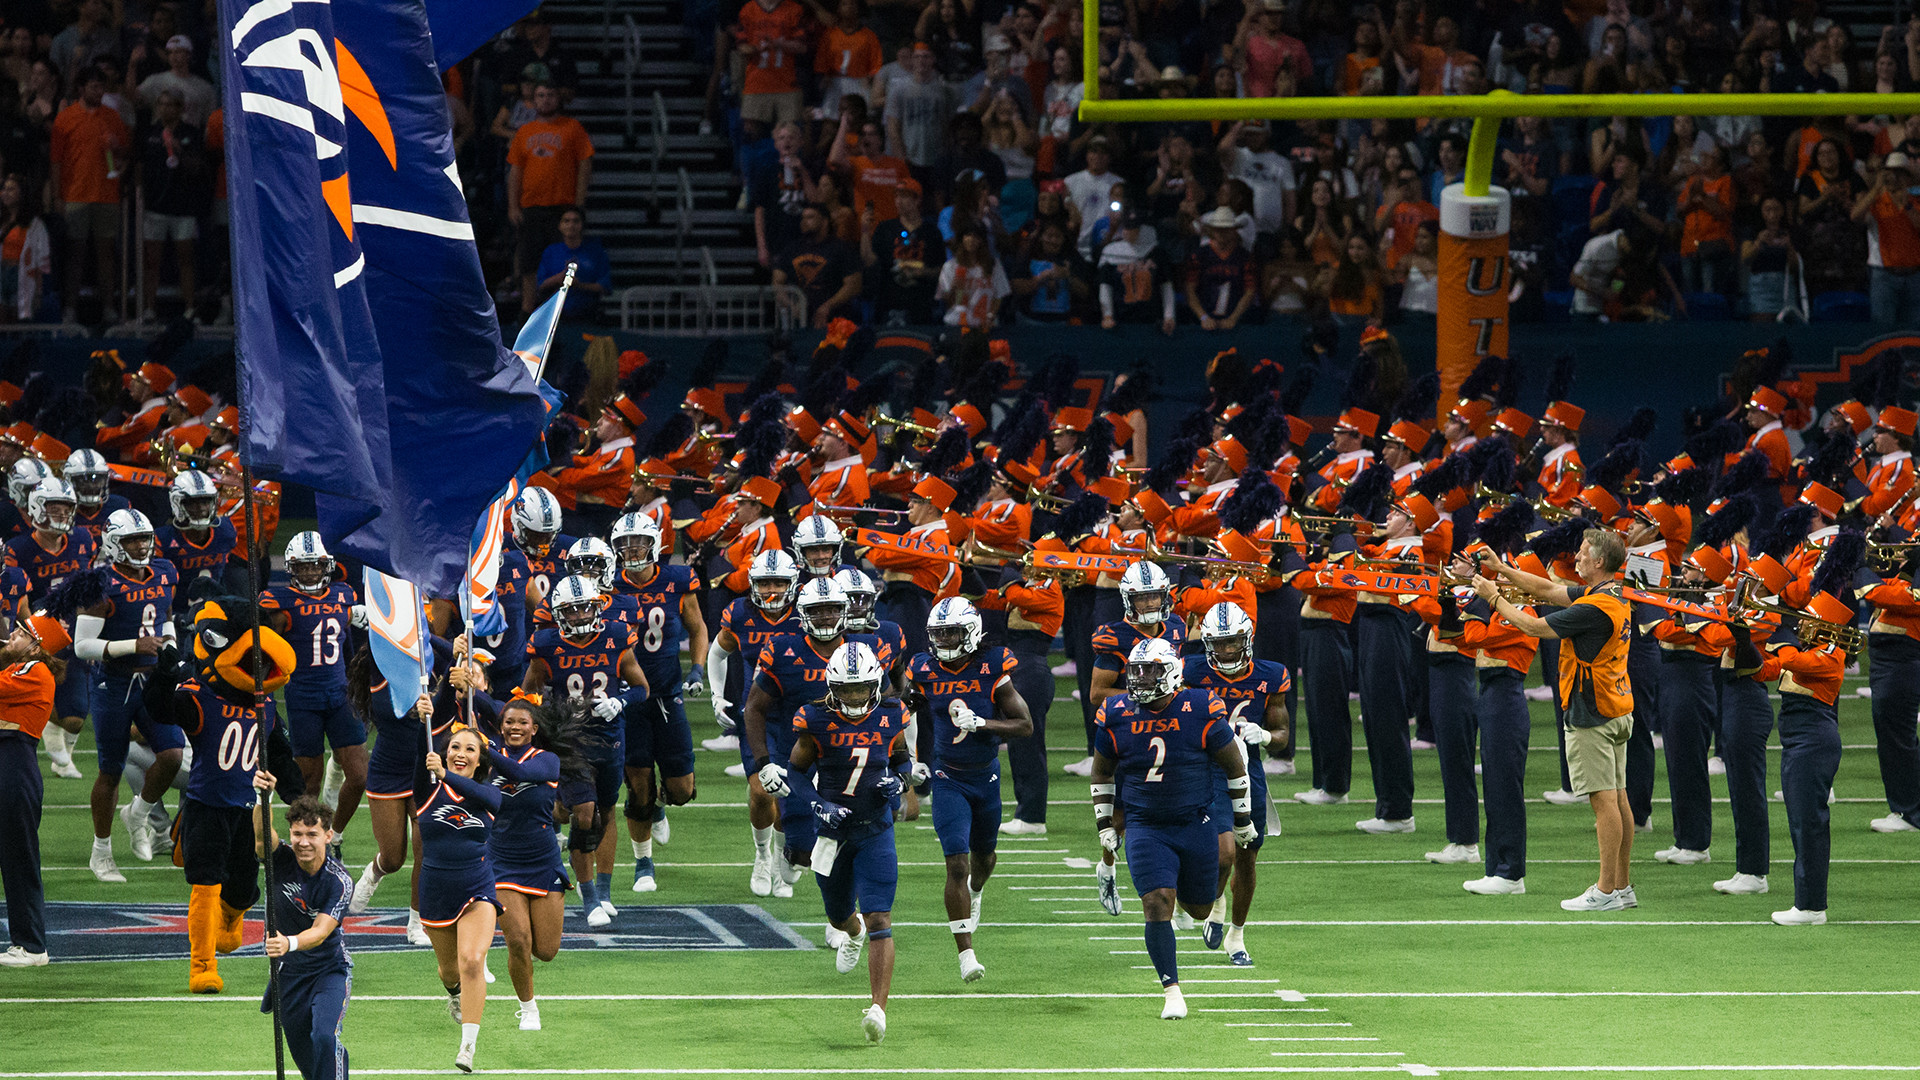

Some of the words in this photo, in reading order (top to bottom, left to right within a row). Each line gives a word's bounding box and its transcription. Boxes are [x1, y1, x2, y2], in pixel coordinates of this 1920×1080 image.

[896, 536, 949, 556] UTSA
[37, 559, 80, 578] UTSA
[182, 553, 224, 569] UTSA
[533, 560, 556, 574] SA
[1076, 556, 1131, 569] UTSA
[496, 581, 517, 597] SA
[1375, 576, 1432, 592] UTSA
[126, 585, 166, 603] UTSA
[626, 592, 667, 605] TSA
[300, 603, 344, 617] UTSA
[1666, 596, 1721, 616] UTSA
[643, 605, 666, 653] 8
[748, 631, 797, 644] UT
[310, 617, 342, 667] 13
[558, 653, 610, 669] UTSA
[932, 679, 982, 696] UTSA
[1614, 676, 1632, 697] 83
[221, 704, 267, 720] UTS
[1228, 699, 1252, 741] 6
[948, 698, 969, 745] 9
[1130, 717, 1181, 735] UTSA
[218, 720, 260, 772] 00
[829, 732, 883, 747] UTSA
[1144, 736, 1167, 783] 2
[842, 747, 870, 797] 7
